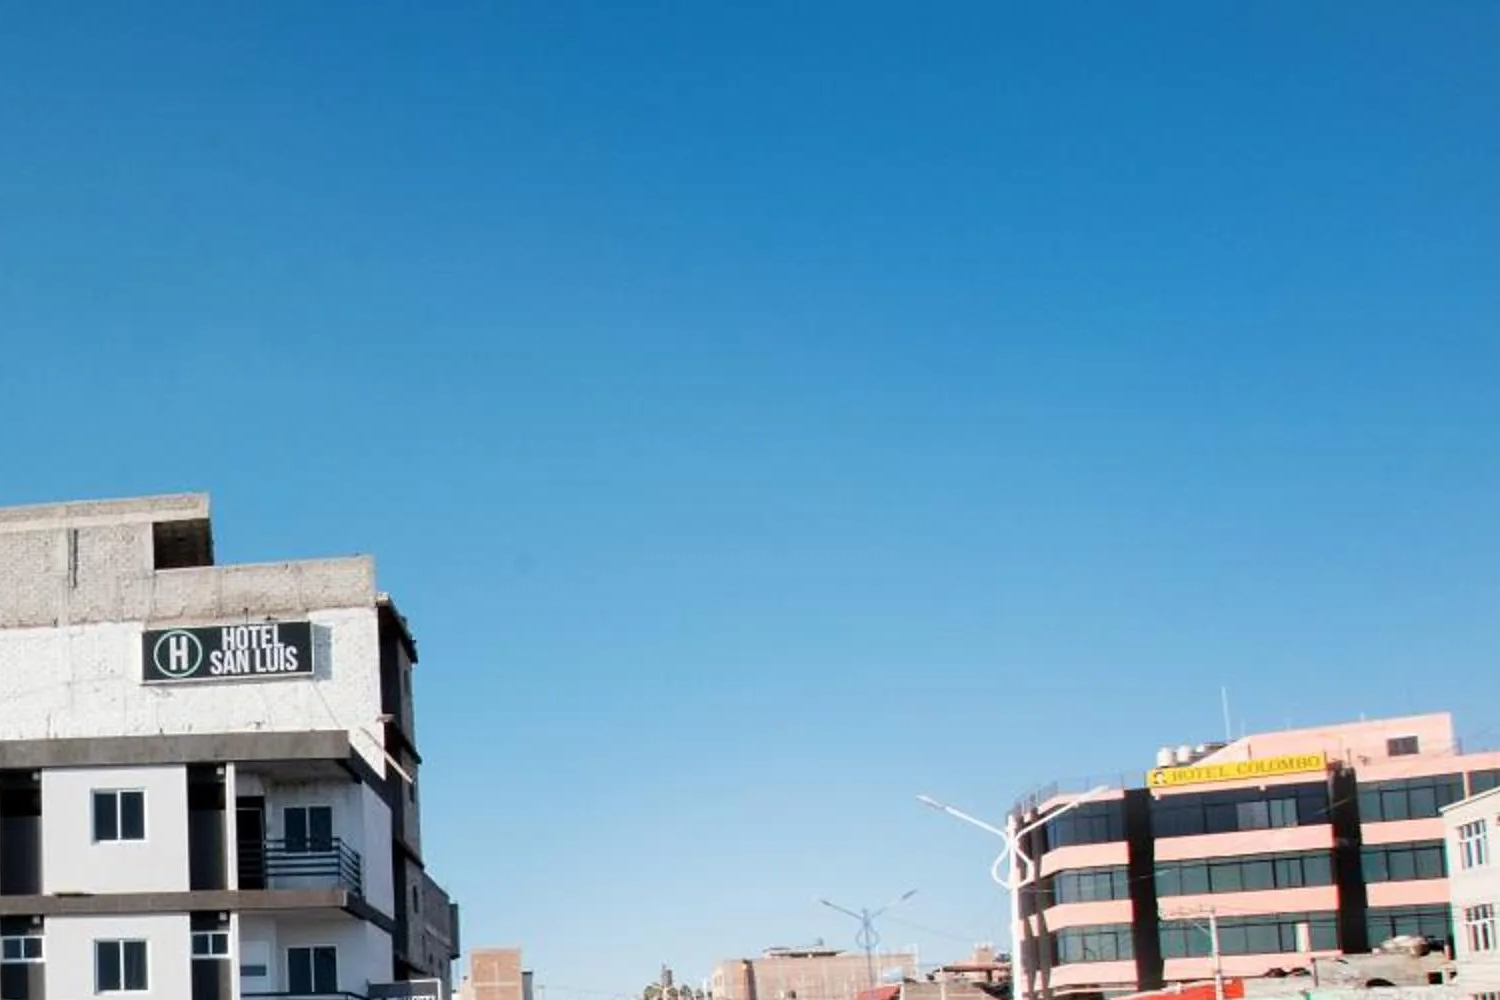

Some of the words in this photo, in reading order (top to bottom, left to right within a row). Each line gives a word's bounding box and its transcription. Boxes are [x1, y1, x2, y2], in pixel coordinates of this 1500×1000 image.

[221, 624, 285, 650] HOTEL
[168, 635, 189, 671] H
[209, 650, 249, 675] SAN
[255, 646, 299, 672] LUIS
[1168, 766, 1226, 782] HOTEL
[1236, 755, 1321, 775] COLOMBO
